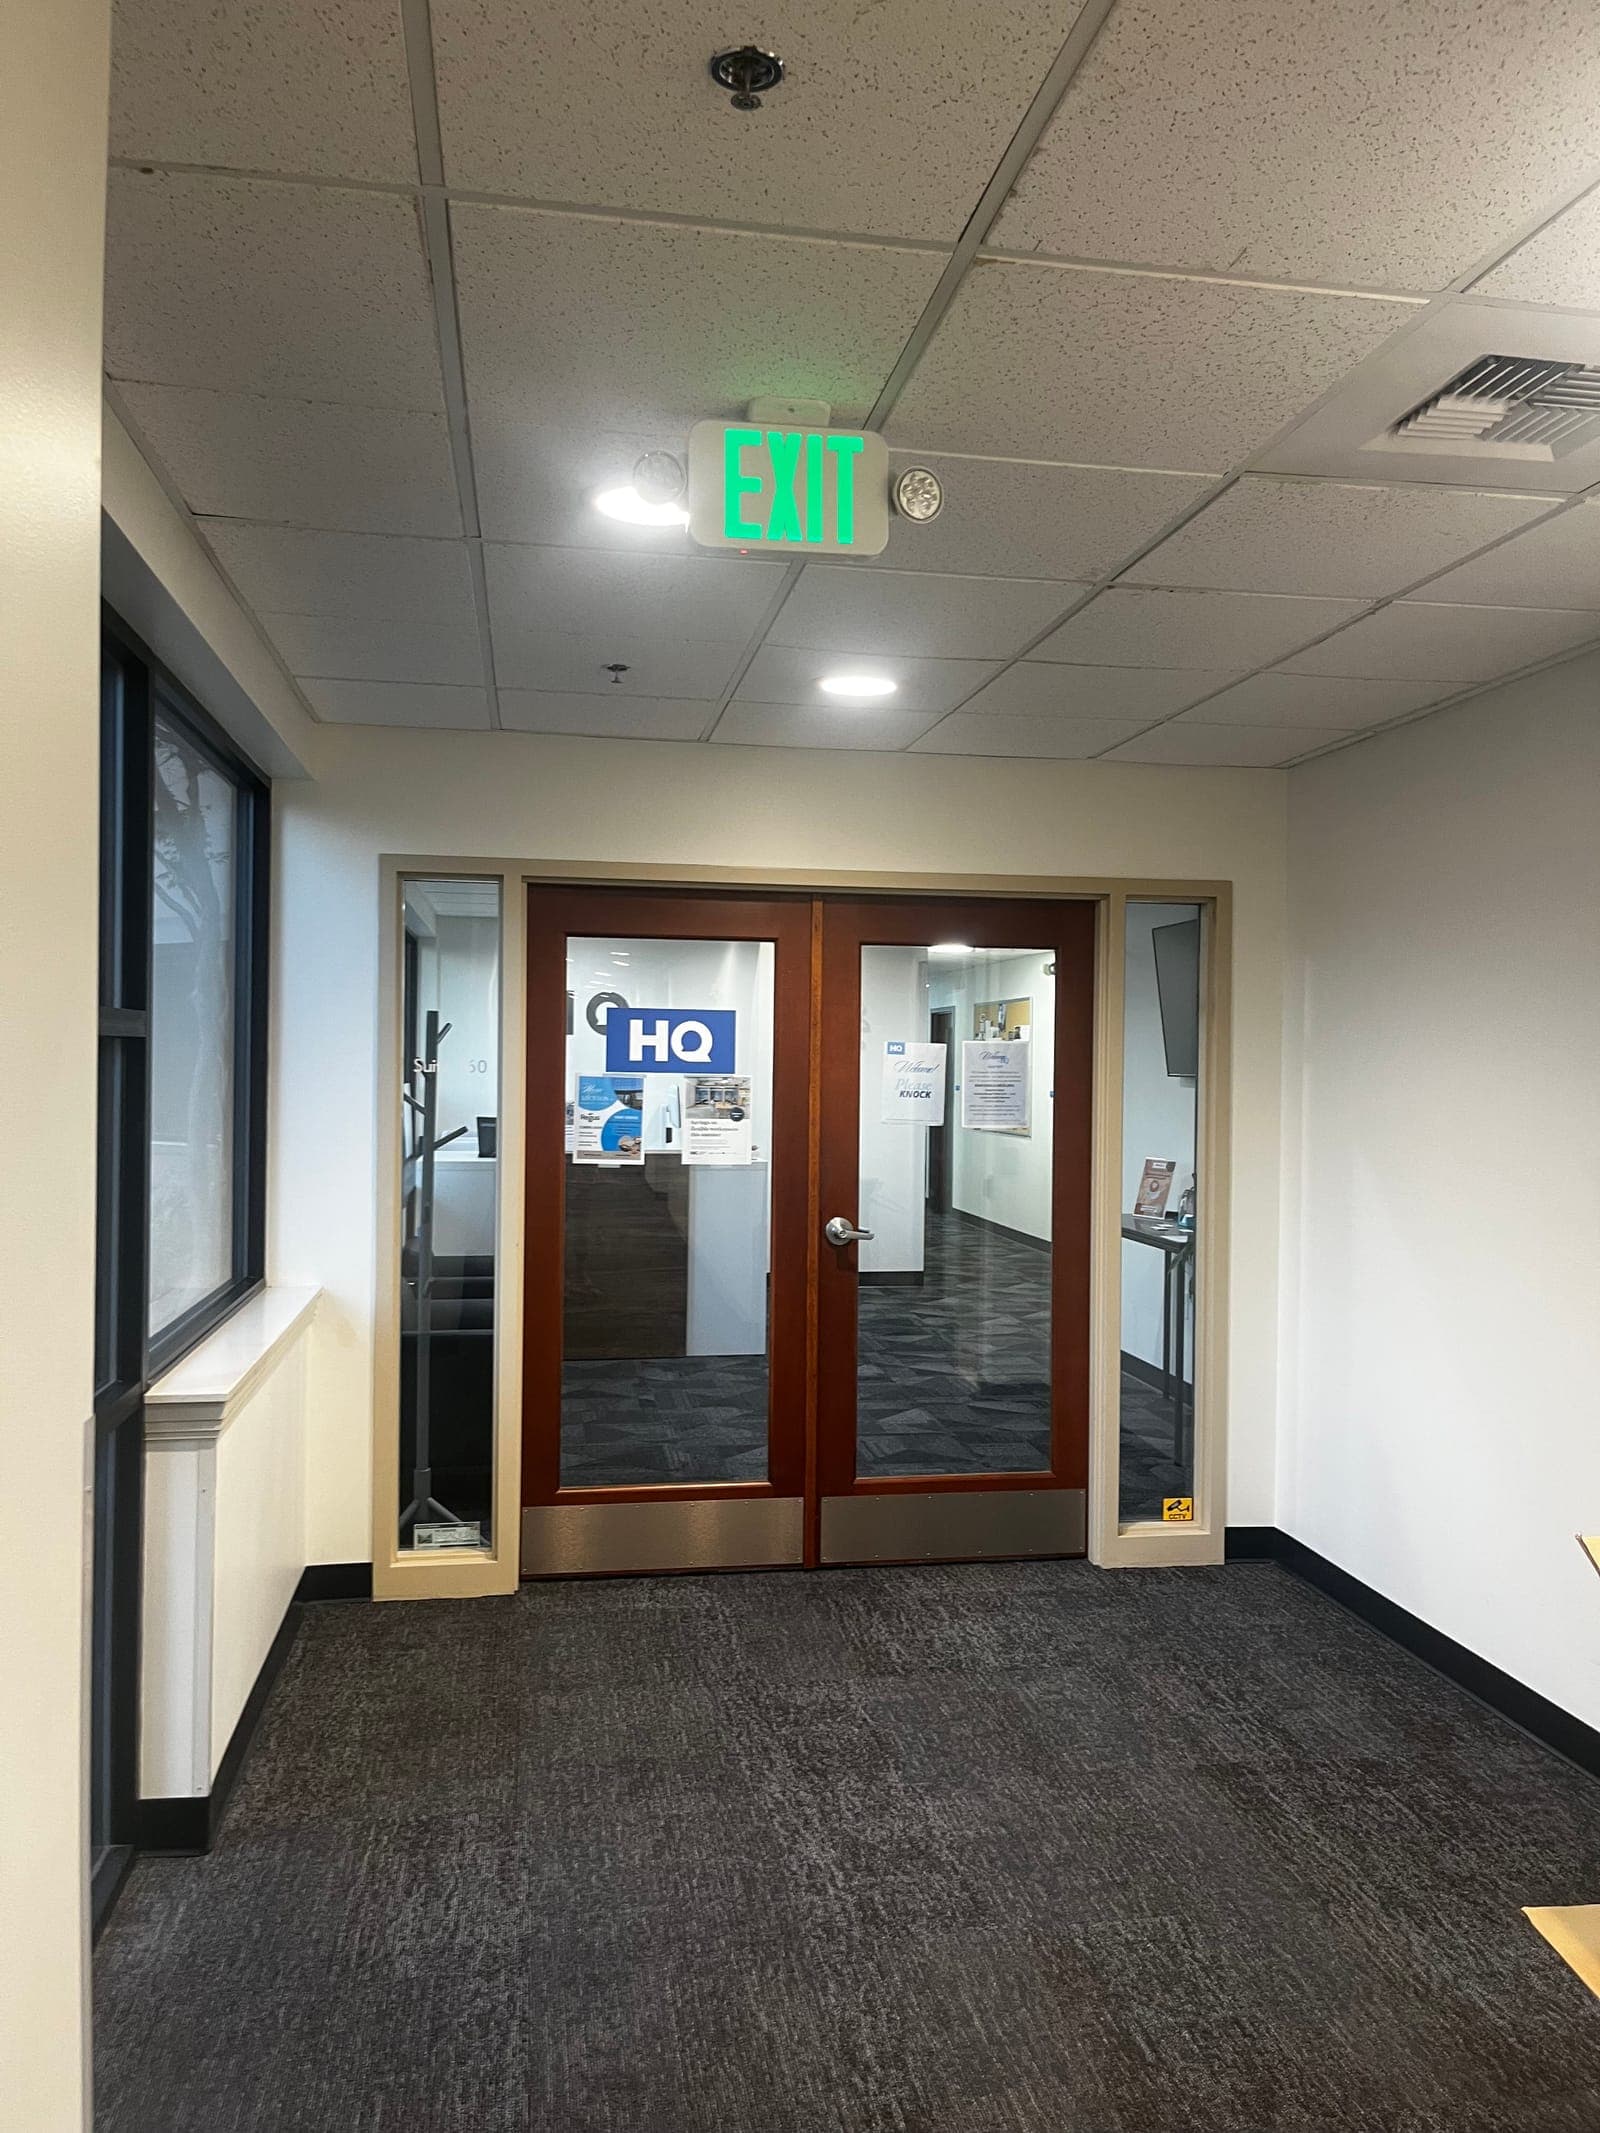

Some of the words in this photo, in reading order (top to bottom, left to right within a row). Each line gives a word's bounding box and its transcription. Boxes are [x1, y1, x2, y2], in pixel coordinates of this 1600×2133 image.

[724, 428, 864, 544] EXIT
[629, 1018, 714, 1063] HQ
[899, 1090, 932, 1099] KNOCK
